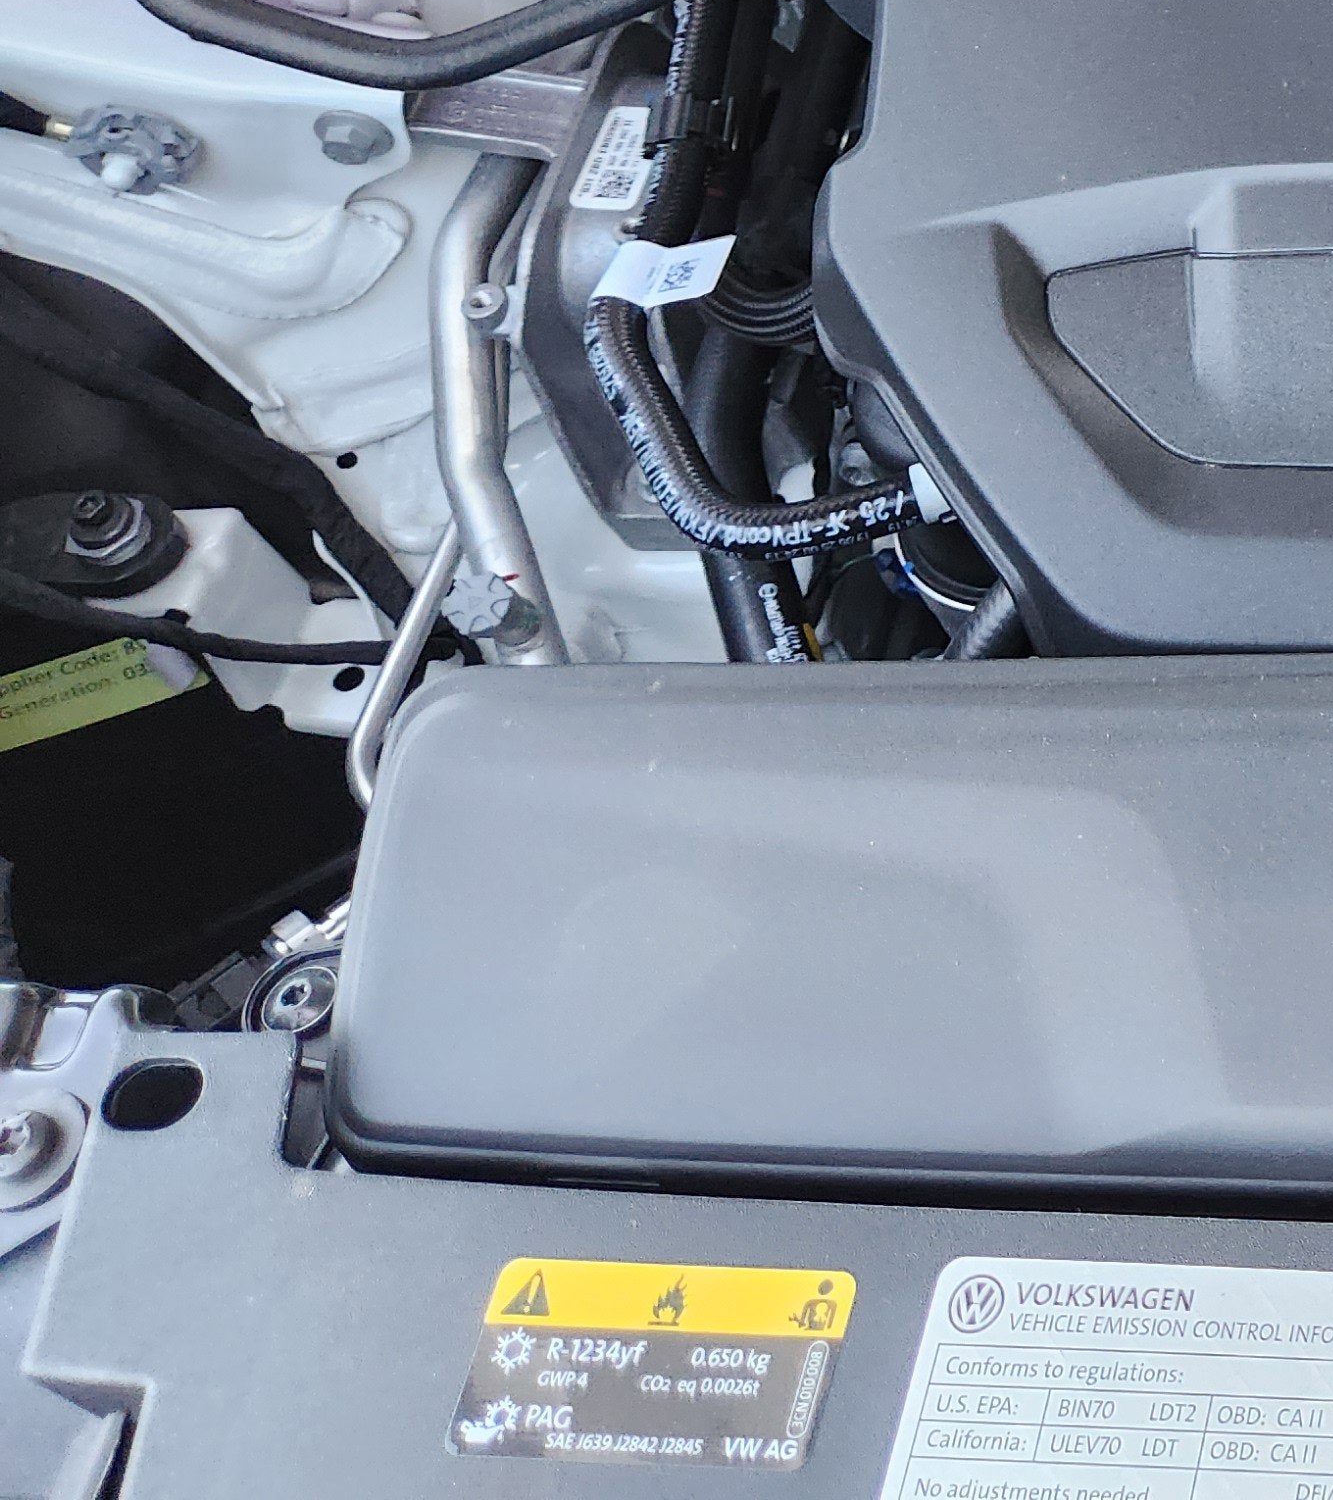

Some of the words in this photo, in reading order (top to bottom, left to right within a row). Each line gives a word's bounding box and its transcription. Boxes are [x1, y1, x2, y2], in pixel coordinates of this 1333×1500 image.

[1016, 1281, 1196, 1313] VOLKSWAGEN
[1009, 1313, 1089, 1334] VEHICLE
[1092, 1316, 1190, 1338] EMISSION
[1192, 1320, 1283, 1343] CONTROL
[546, 1337, 648, 1369] R-1234yf
[690, 1346, 744, 1368] 0.650
[746, 1348, 772, 1376] kg
[806, 1351, 824, 1377] 008
[537, 1370, 576, 1388] GWP
[577, 1372, 589, 1388] 4
[945, 1355, 1039, 1378] Conforms
[1044, 1360, 1064, 1379] to
[1067, 1360, 1184, 1386] regulations:
[677, 1379, 697, 1397] eq
[700, 1377, 761, 1397] 0.0026t
[799, 1377, 817, 1401] 010
[525, 1403, 574, 1429] PAG
[935, 1393, 971, 1415] U.S.
[975, 1395, 1019, 1416] EPA:
[1057, 1398, 1116, 1420] BIN70
[1149, 1402, 1198, 1424] LDT2
[1216, 1405, 1267, 1426] OBD:
[1276, 1407, 1306, 1428] CA
[544, 1431, 576, 1451] SAE
[658, 1437, 705, 1456] J2845
[723, 1436, 764, 1459] VW
[764, 1439, 799, 1461] AG
[926, 1428, 1027, 1452] California:
[1049, 1433, 1123, 1456] ULEV70
[1141, 1437, 1181, 1459] LDT
[1209, 1440, 1260, 1462] OBD:
[1270, 1443, 1301, 1464] CA
[913, 1477, 943, 1498] No
[946, 1479, 1071, 1500] adjustments
